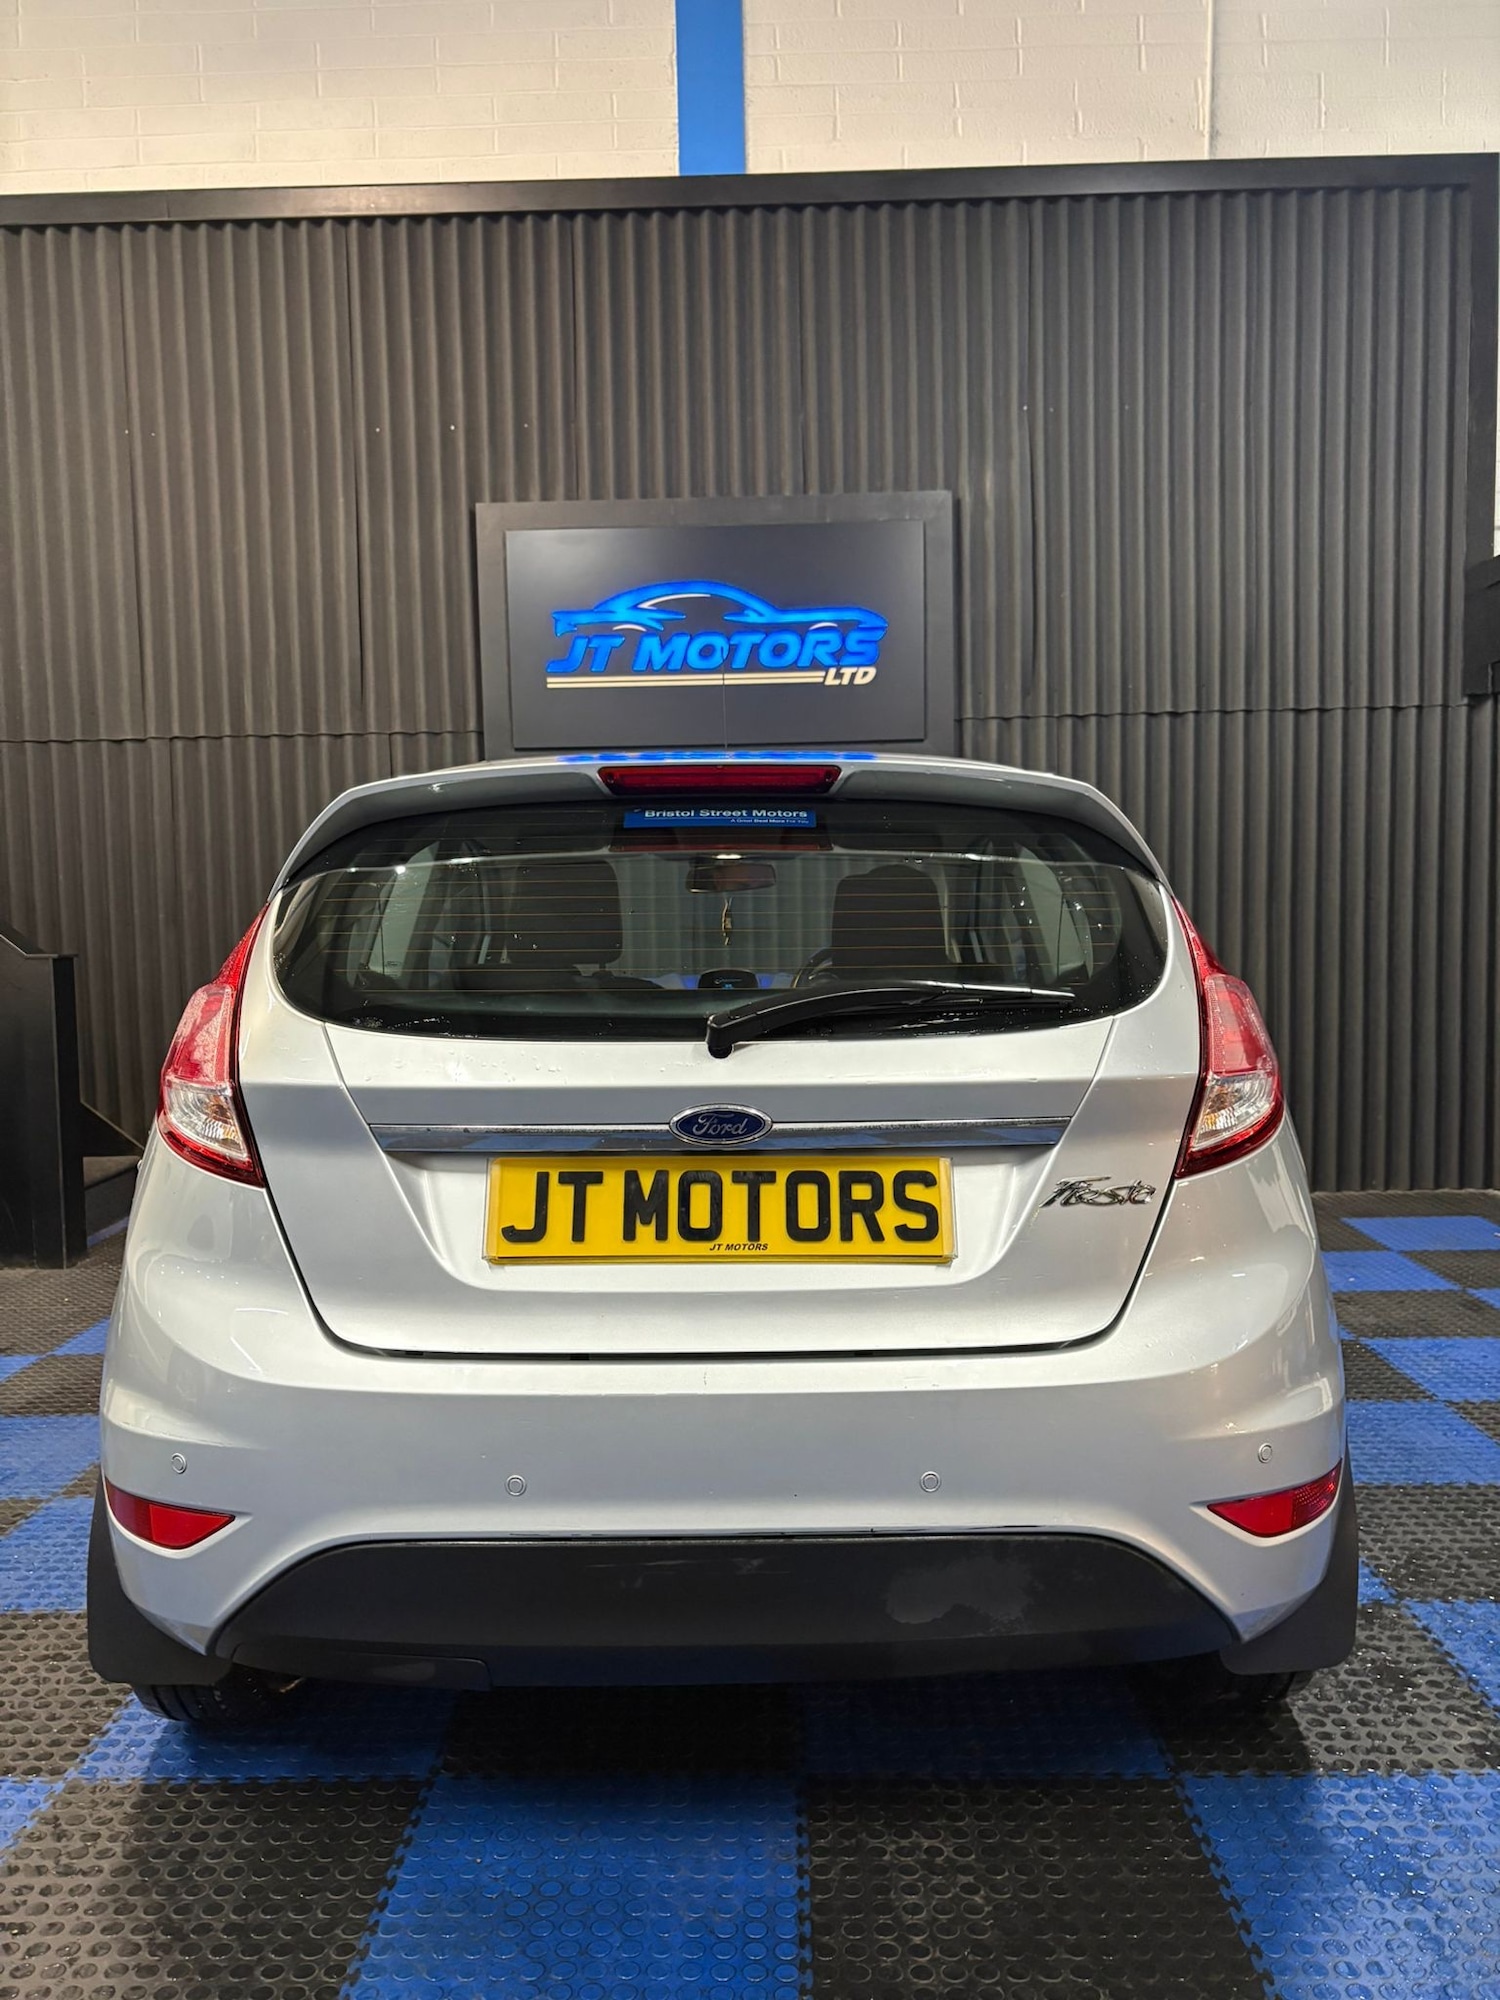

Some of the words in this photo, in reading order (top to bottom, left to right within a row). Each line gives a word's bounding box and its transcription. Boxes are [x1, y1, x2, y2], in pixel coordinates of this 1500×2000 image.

[547, 634, 625, 673] JT
[632, 627, 884, 671] MOTORS
[824, 667, 876, 685] LTD
[645, 810, 695, 818] Bristol
[699, 809, 748, 817] Street
[752, 810, 808, 818] Motors
[692, 1113, 748, 1135] Ford
[501, 1171, 604, 1242] JT
[622, 1169, 940, 1242] MOTORS
[709, 1243, 722, 1251] JT
[725, 1243, 768, 1251] MOTORS
